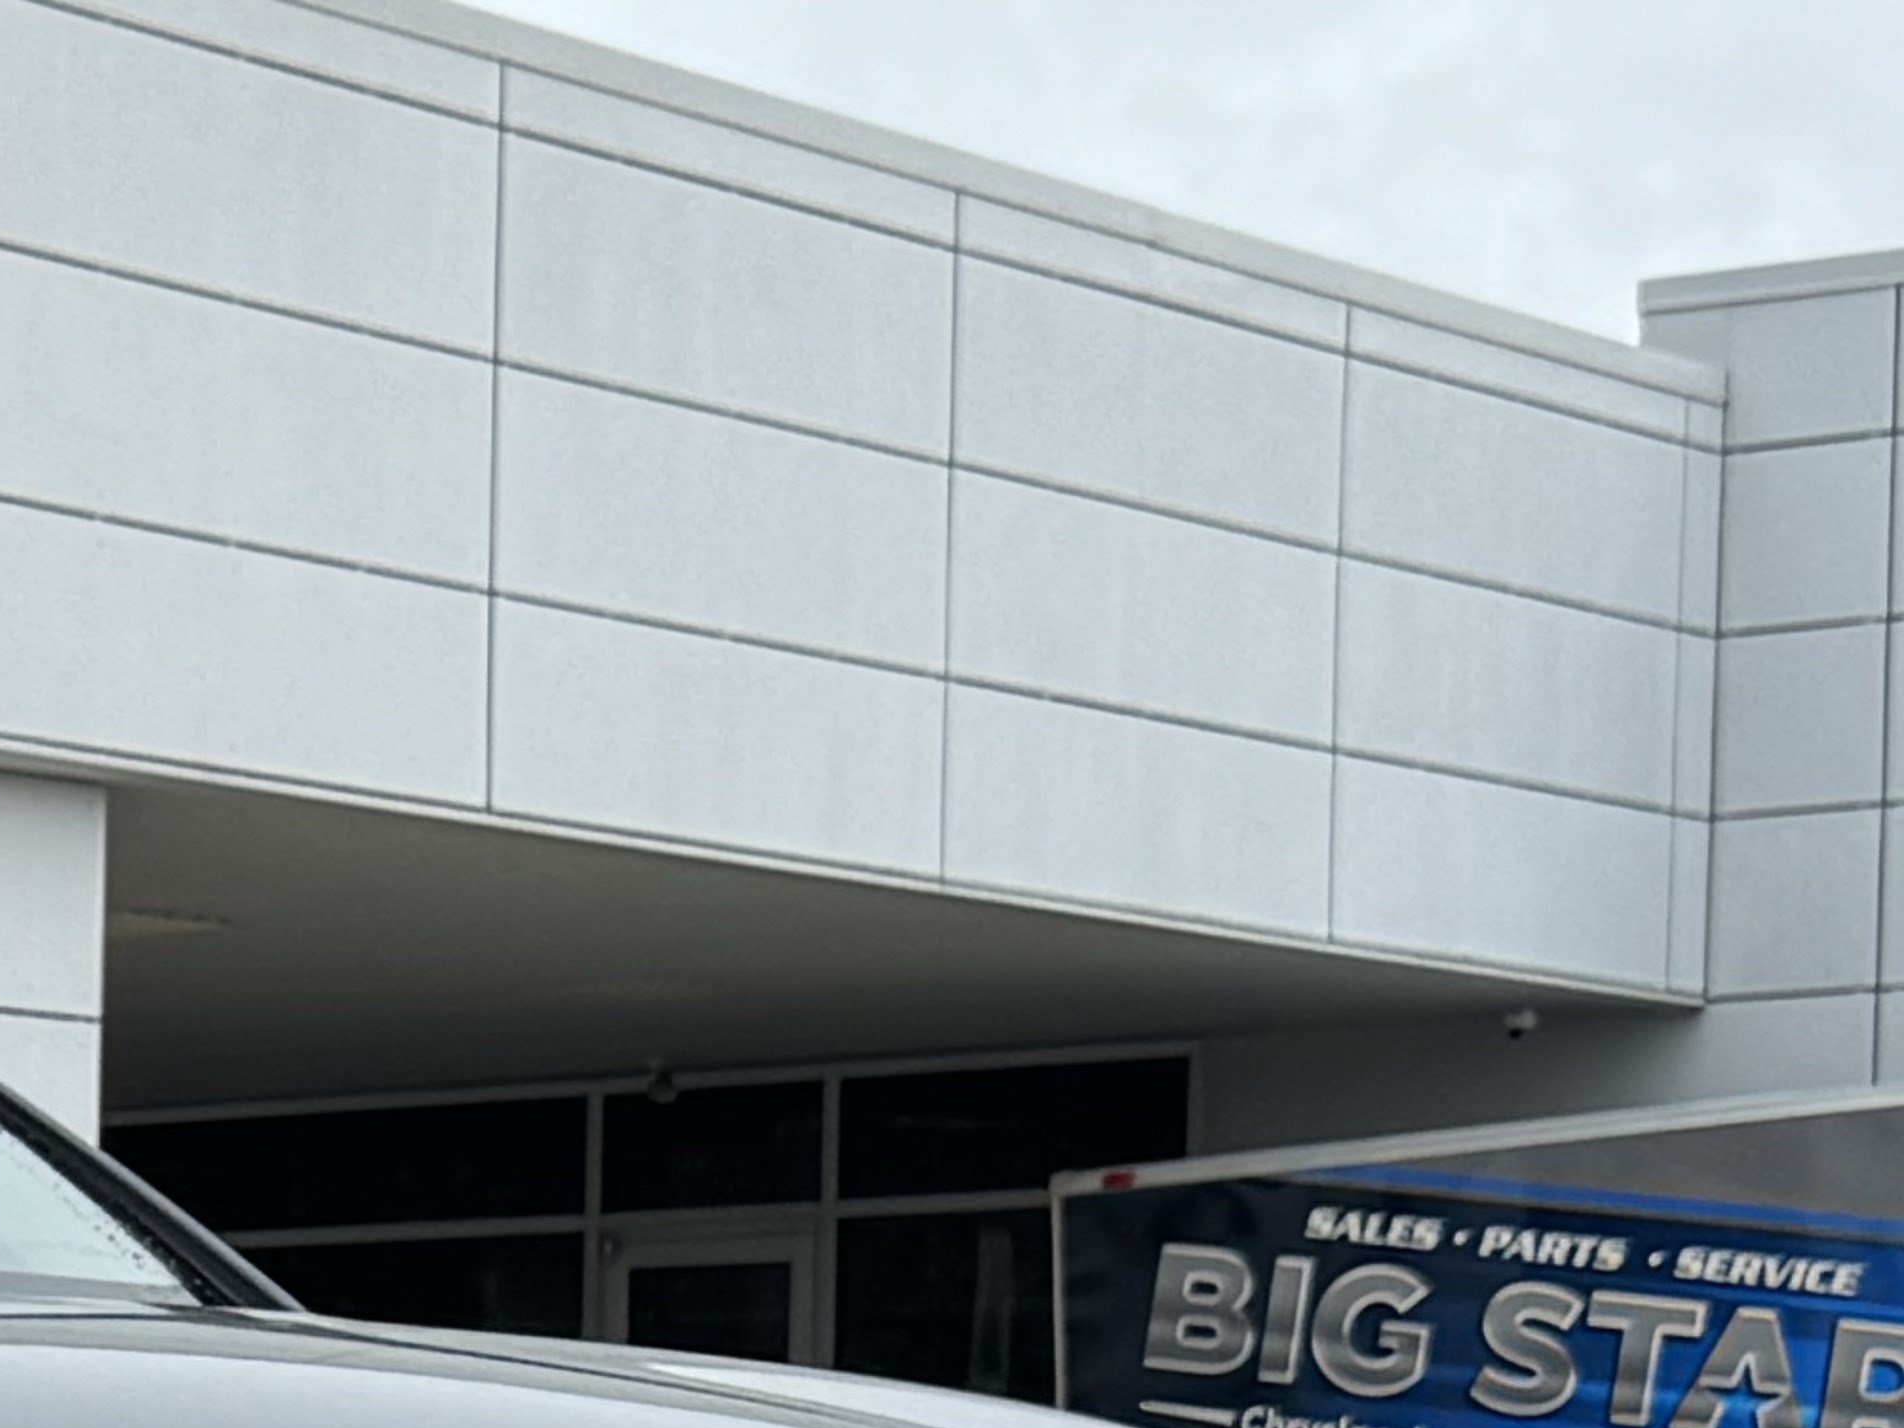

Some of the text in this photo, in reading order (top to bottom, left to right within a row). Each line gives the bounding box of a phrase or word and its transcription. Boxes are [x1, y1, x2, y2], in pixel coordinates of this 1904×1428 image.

[1305, 1205, 1865, 1298] SALES PARTS SERVICE
[1141, 1242, 1434, 1399] BIG
